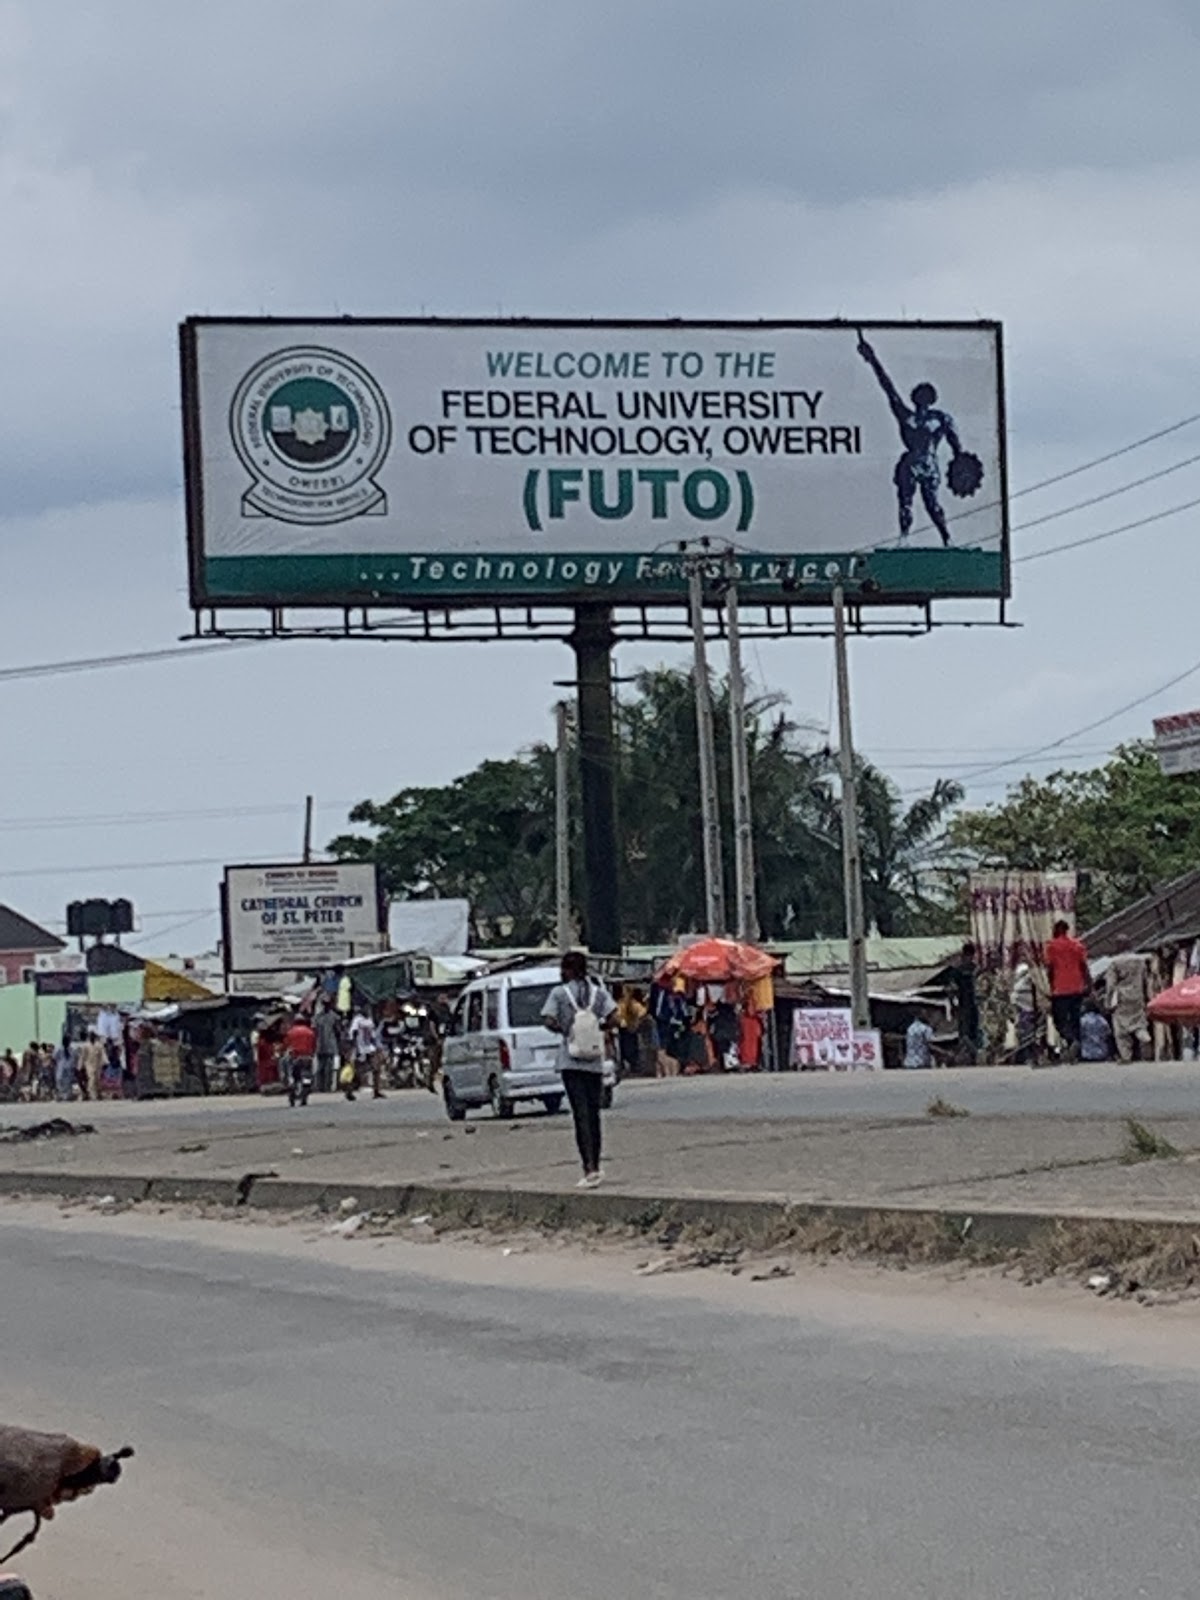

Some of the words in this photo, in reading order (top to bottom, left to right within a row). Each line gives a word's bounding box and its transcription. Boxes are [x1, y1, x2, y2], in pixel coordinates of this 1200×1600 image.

[486, 351, 650, 379] WELCOME
[662, 351, 703, 378] TO
[715, 352, 776, 378] THE
[441, 390, 607, 420] FEDERAL
[617, 389, 823, 420] UNIVERSITY
[408, 425, 457, 454] OF
[466, 425, 713, 461] TECHNOLOGY,
[723, 425, 861, 455] OWERRI
[522, 468, 754, 532] (FUTO)
[240, 897, 310, 911] CATHEDRAL
[314, 895, 363, 909] CHURCH
[261, 912, 277, 925] OF
[304, 910, 344, 924] PETER
